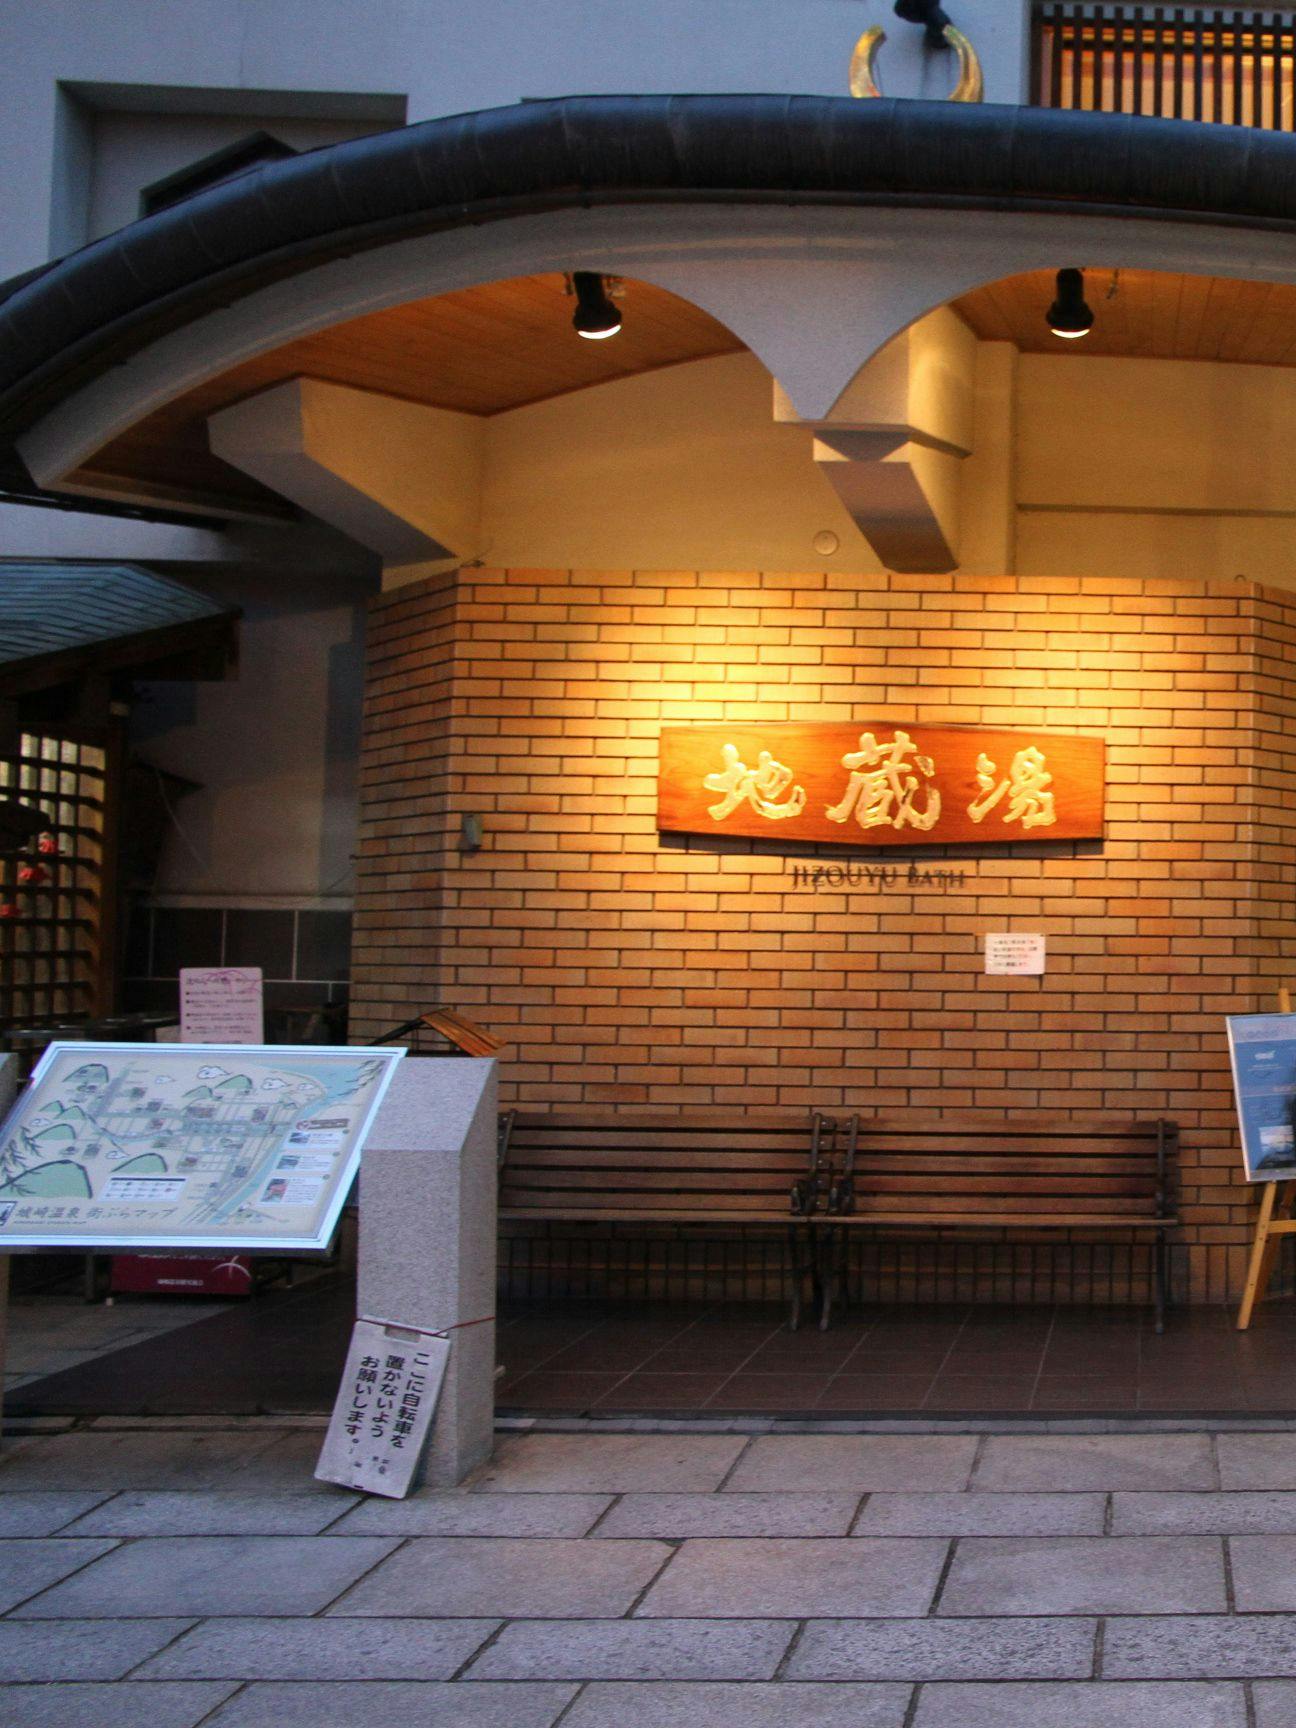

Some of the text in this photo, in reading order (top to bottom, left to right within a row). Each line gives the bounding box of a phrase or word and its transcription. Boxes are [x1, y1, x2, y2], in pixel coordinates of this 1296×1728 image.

[703, 731, 1057, 830] 地蔵湯
[907, 866, 965, 888] BATH
[370, 1355, 405, 1437] 置かないよう
[390, 1352, 430, 1448] ここに自転車を
